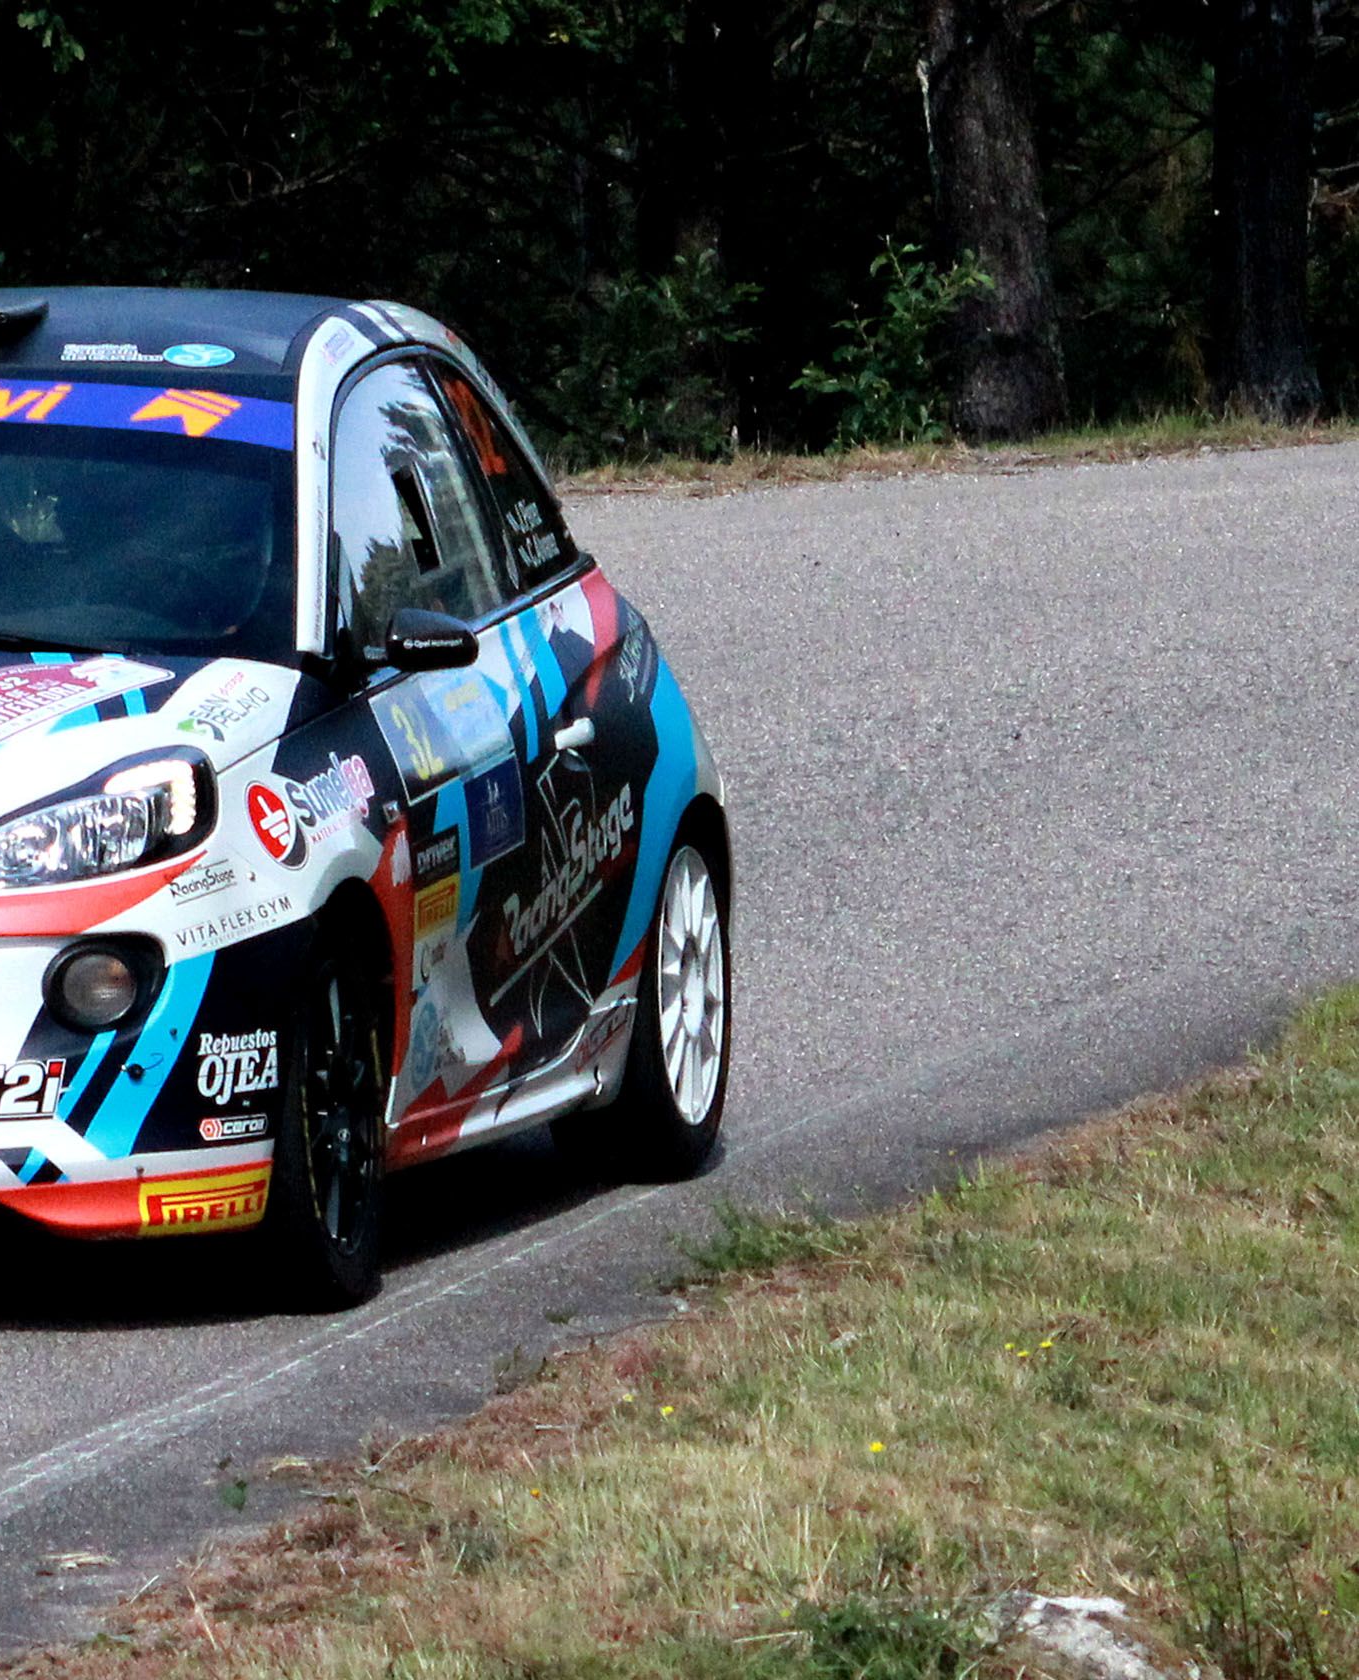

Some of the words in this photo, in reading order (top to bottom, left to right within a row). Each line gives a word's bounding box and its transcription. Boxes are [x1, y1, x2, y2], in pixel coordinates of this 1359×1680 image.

[212, 686, 270, 728] PELAYO
[284, 752, 375, 828] Sumelga
[169, 869, 236, 899] RacingStage
[177, 923, 219, 947] VITA
[220, 908, 256, 934] FLEX
[257, 896, 293, 920] GYM
[197, 1028, 277, 1057] Repuestos
[197, 1047, 279, 1106] OJEA
[145, 1179, 267, 1227] PIRELLI
